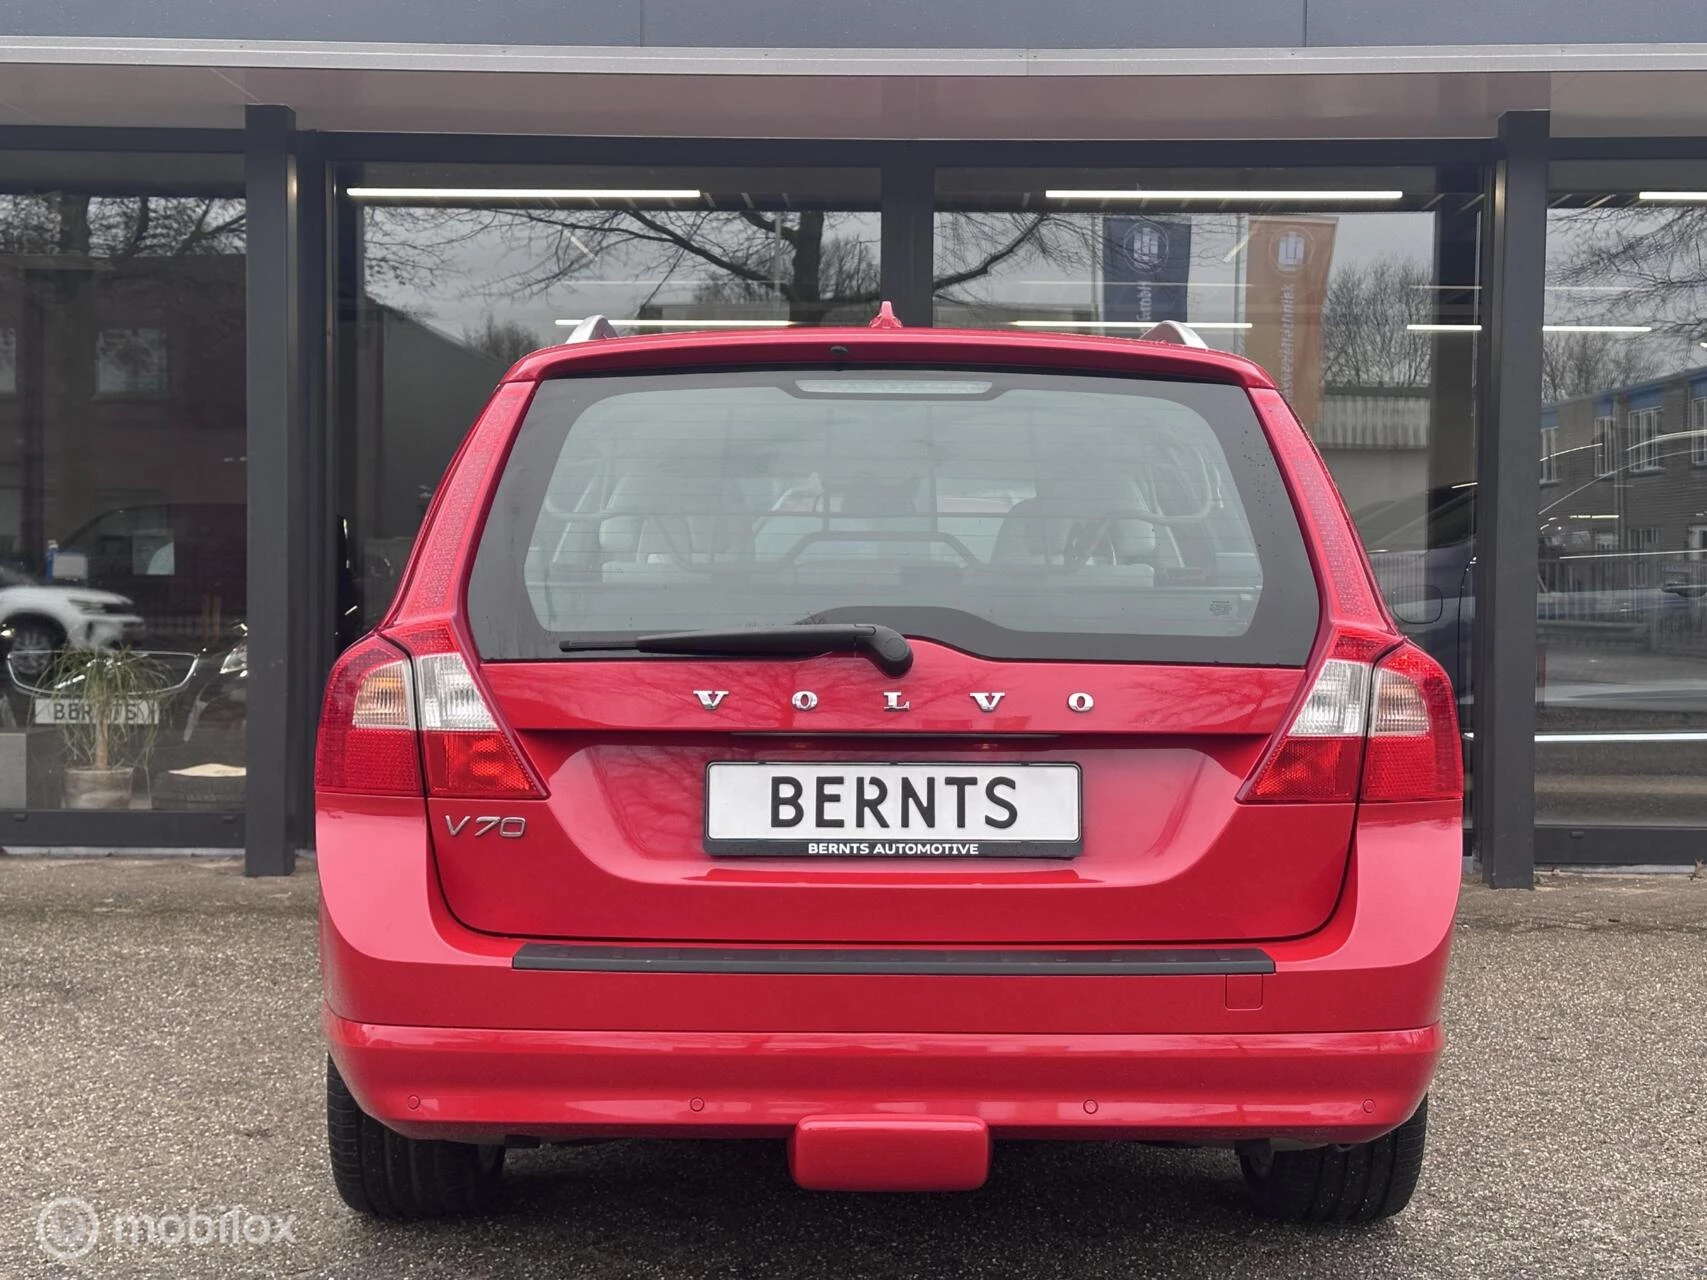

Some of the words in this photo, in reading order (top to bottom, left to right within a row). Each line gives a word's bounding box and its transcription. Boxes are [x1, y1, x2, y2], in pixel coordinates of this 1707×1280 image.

[693, 690, 1095, 713] VOLVO
[770, 776, 1018, 829] BERNTS
[808, 843, 869, 855] BERNTS
[873, 842, 979, 855] AUTOMOTIVE
